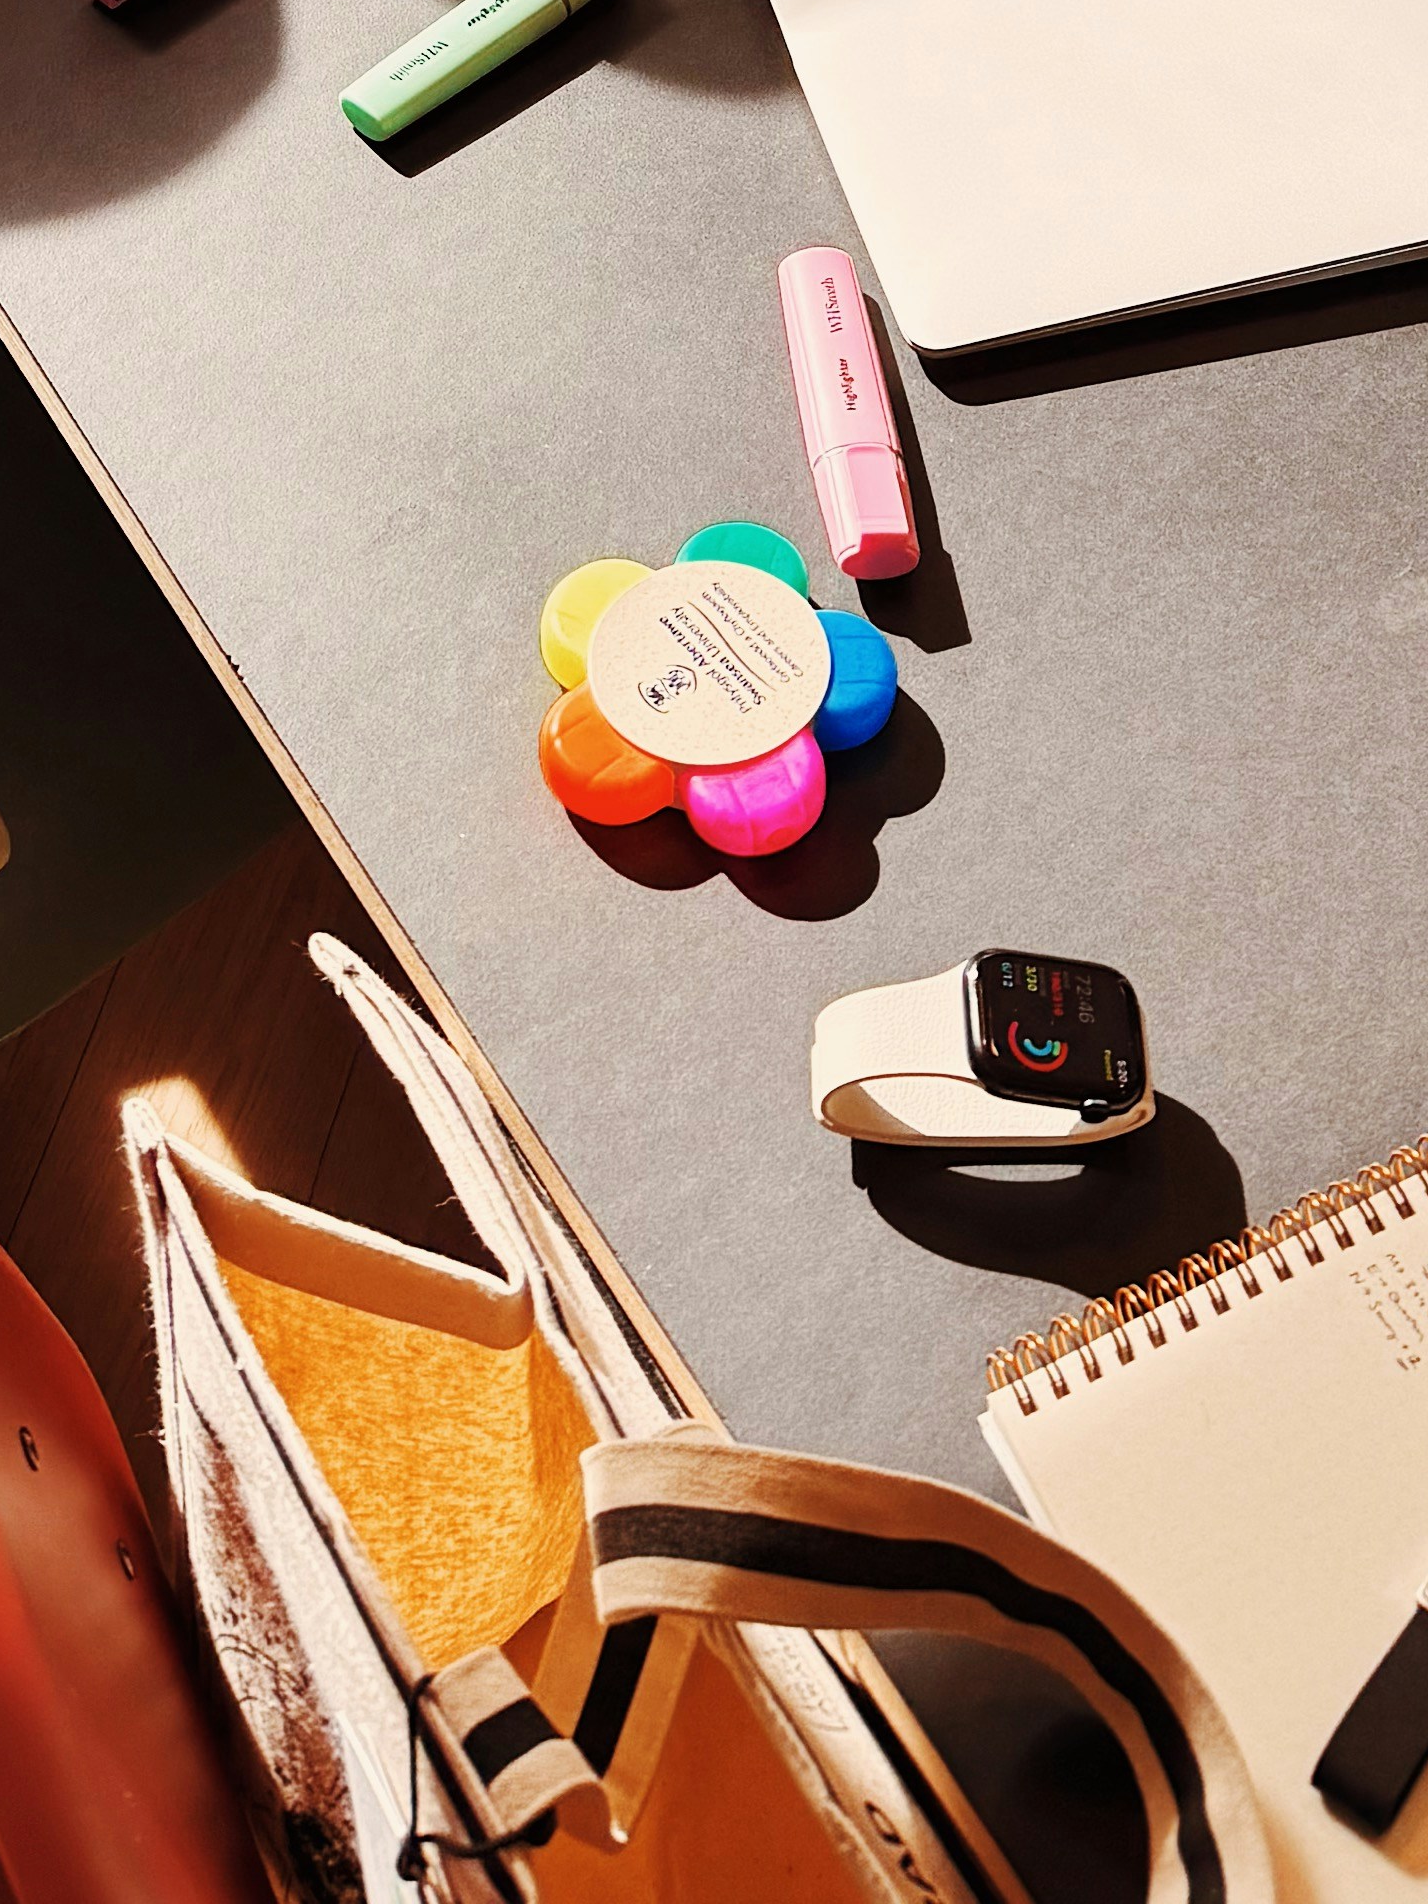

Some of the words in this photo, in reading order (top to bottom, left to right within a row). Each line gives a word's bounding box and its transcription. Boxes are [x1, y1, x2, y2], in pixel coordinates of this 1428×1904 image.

[820, 276, 844, 334] WHSmith
[659, 616, 710, 667] Abertawe
[671, 607, 720, 658] University
[719, 657, 766, 705] Swansea
